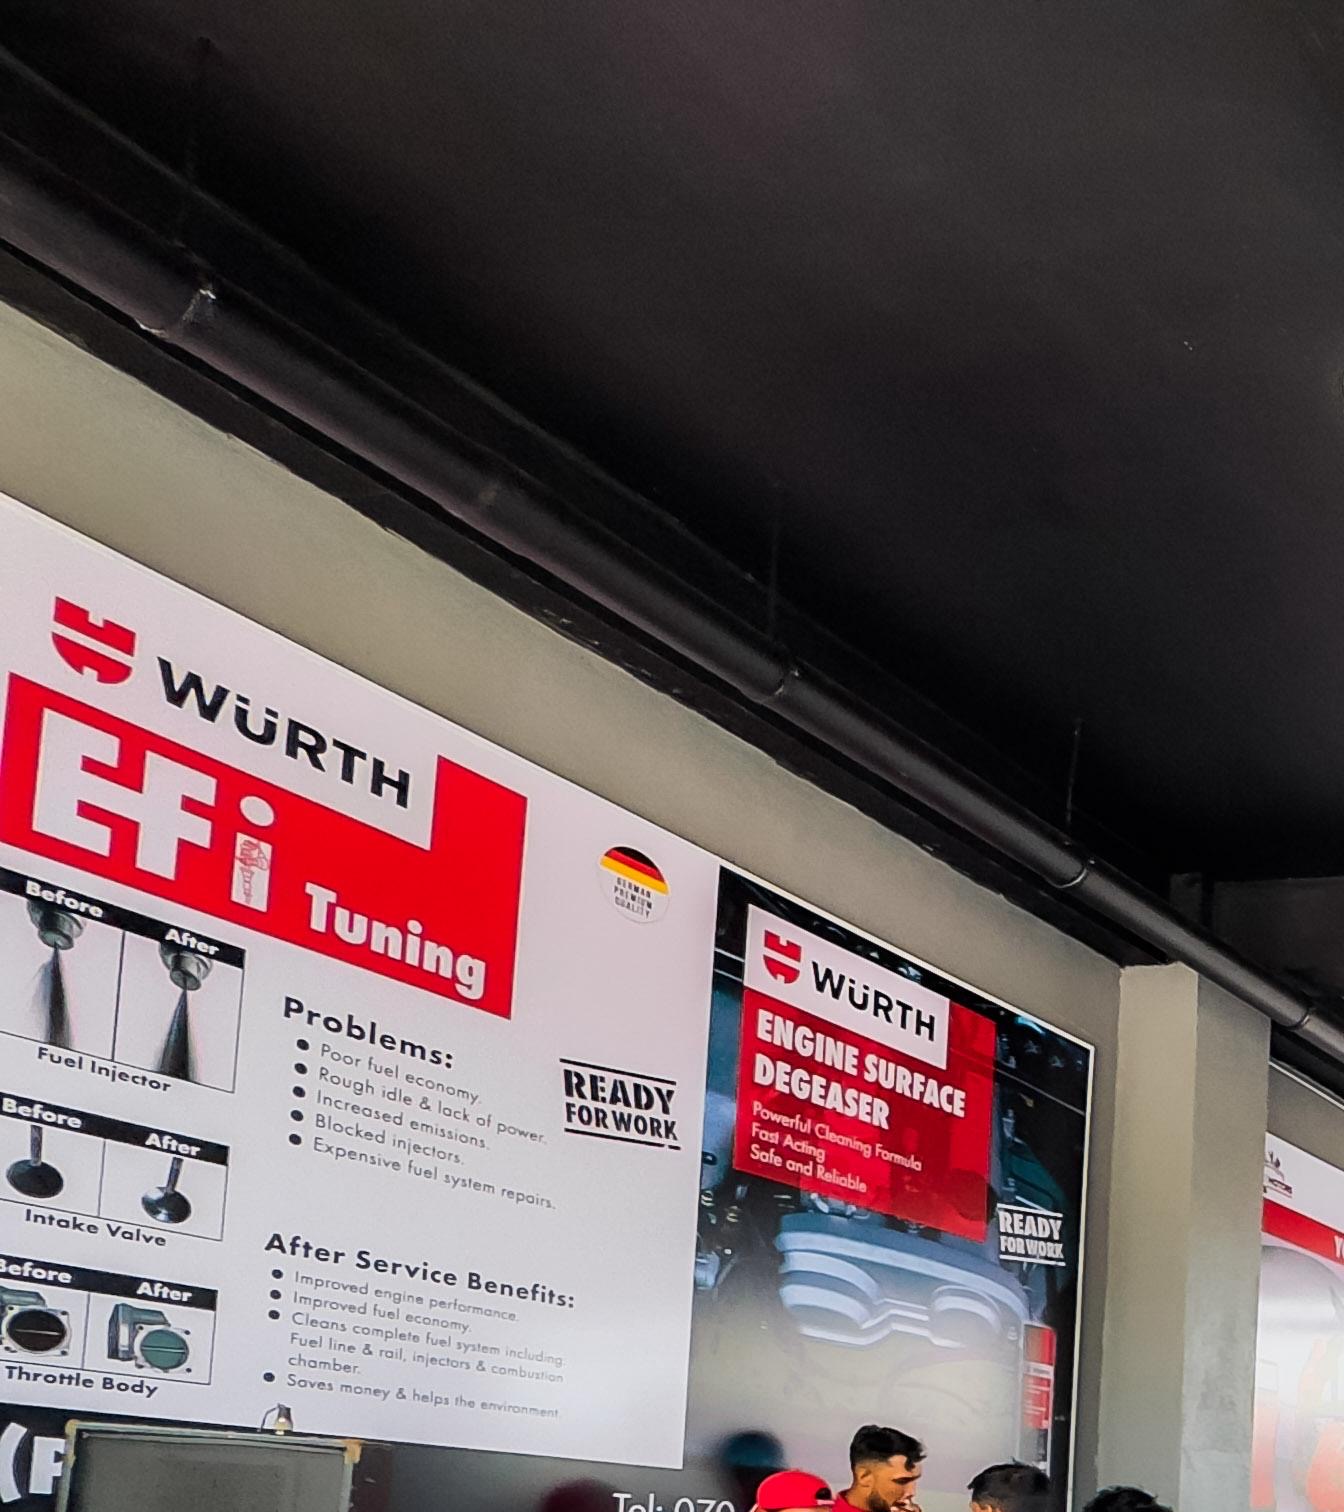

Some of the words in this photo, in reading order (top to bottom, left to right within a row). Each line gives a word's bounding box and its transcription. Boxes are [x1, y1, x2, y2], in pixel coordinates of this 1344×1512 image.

[157, 656, 410, 809] WÜRTH
[26, 880, 104, 918] Before
[165, 928, 220, 956] After
[304, 881, 486, 1000] Tuning
[811, 960, 936, 1042] WÜRTH
[283, 996, 454, 1069] Problems:
[37, 1046, 83, 1070] Fuel
[91, 1060, 172, 1093] Injector
[321, 1043, 361, 1068] Poor
[368, 1056, 399, 1079] fuel
[405, 1072, 482, 1105] economy.
[757, 1008, 860, 1077] ENGINE
[864, 1052, 967, 1118] SURFACE
[319, 1066, 375, 1096] Rough
[382, 1084, 412, 1106] idle
[419, 1097, 432, 1111] &
[438, 1100, 470, 1122] lack
[476, 1114, 492, 1128] of
[563, 1069, 675, 1116] READY
[754, 1053, 891, 1131] DEGEASER
[2, 1098, 82, 1129] Before
[145, 1133, 201, 1157] After
[315, 1113, 385, 1145] Blocked
[392, 1132, 465, 1165] injectors.
[317, 1090, 403, 1126] Increased
[410, 1118, 490, 1150] emissions.
[565, 1102, 608, 1129] FOR
[612, 1109, 678, 1141] WORK
[751, 1123, 780, 1145] Fast
[782, 1134, 826, 1163] Acting
[752, 1101, 812, 1134] Powerful
[814, 1122, 872, 1159] Cleaning
[875, 1143, 923, 1172] Formula
[313, 1137, 401, 1172] Expensive
[408, 1160, 438, 1180] fuel
[444, 1173, 495, 1194] system
[500, 1187, 556, 1209] repairs.
[750, 1144, 782, 1168] Safe
[786, 1156, 813, 1178] and
[817, 1165, 867, 1194] Reliable
[25, 1208, 98, 1234] Intake
[106, 1223, 167, 1247] Valve
[999, 1211, 1062, 1241] READY
[1000, 1235, 1025, 1254] FOR
[1025, 1239, 1064, 1259] WORK
[0, 1258, 72, 1284] Before
[136, 1281, 193, 1303] After
[264, 1233, 346, 1264] After
[355, 1250, 458, 1286] Service
[468, 1272, 575, 1308] Benefits:
[295, 1270, 369, 1296] Improved
[374, 1287, 424, 1305] engine
[429, 1298, 520, 1323] performance.
[291, 1312, 347, 1332] Cleans
[352, 1323, 420, 1345] complete
[425, 1331, 452, 1348] fuel
[456, 1339, 501, 1357] system
[293, 1291, 367, 1317] Improved
[373, 1302, 400, 1320] fuel
[405, 1312, 472, 1335] economy.
[5, 1365, 94, 1390] Throttle
[102, 1376, 159, 1398] Body
[288, 1353, 361, 1375] chamber.
[290, 1332, 323, 1349] Fuel
[328, 1337, 356, 1354] line
[362, 1344, 374, 1356] &
[379, 1347, 406, 1364] rail,
[412, 1351, 471, 1372] injectors
[475, 1360, 487, 1373] &
[491, 1363, 563, 1383] combustion
[287, 1373, 334, 1392] Saves
[340, 1382, 391, 1401] money
[395, 1388, 407, 1400] &
[412, 1388, 450, 1407] helps
[455, 1395, 476, 1408] the
